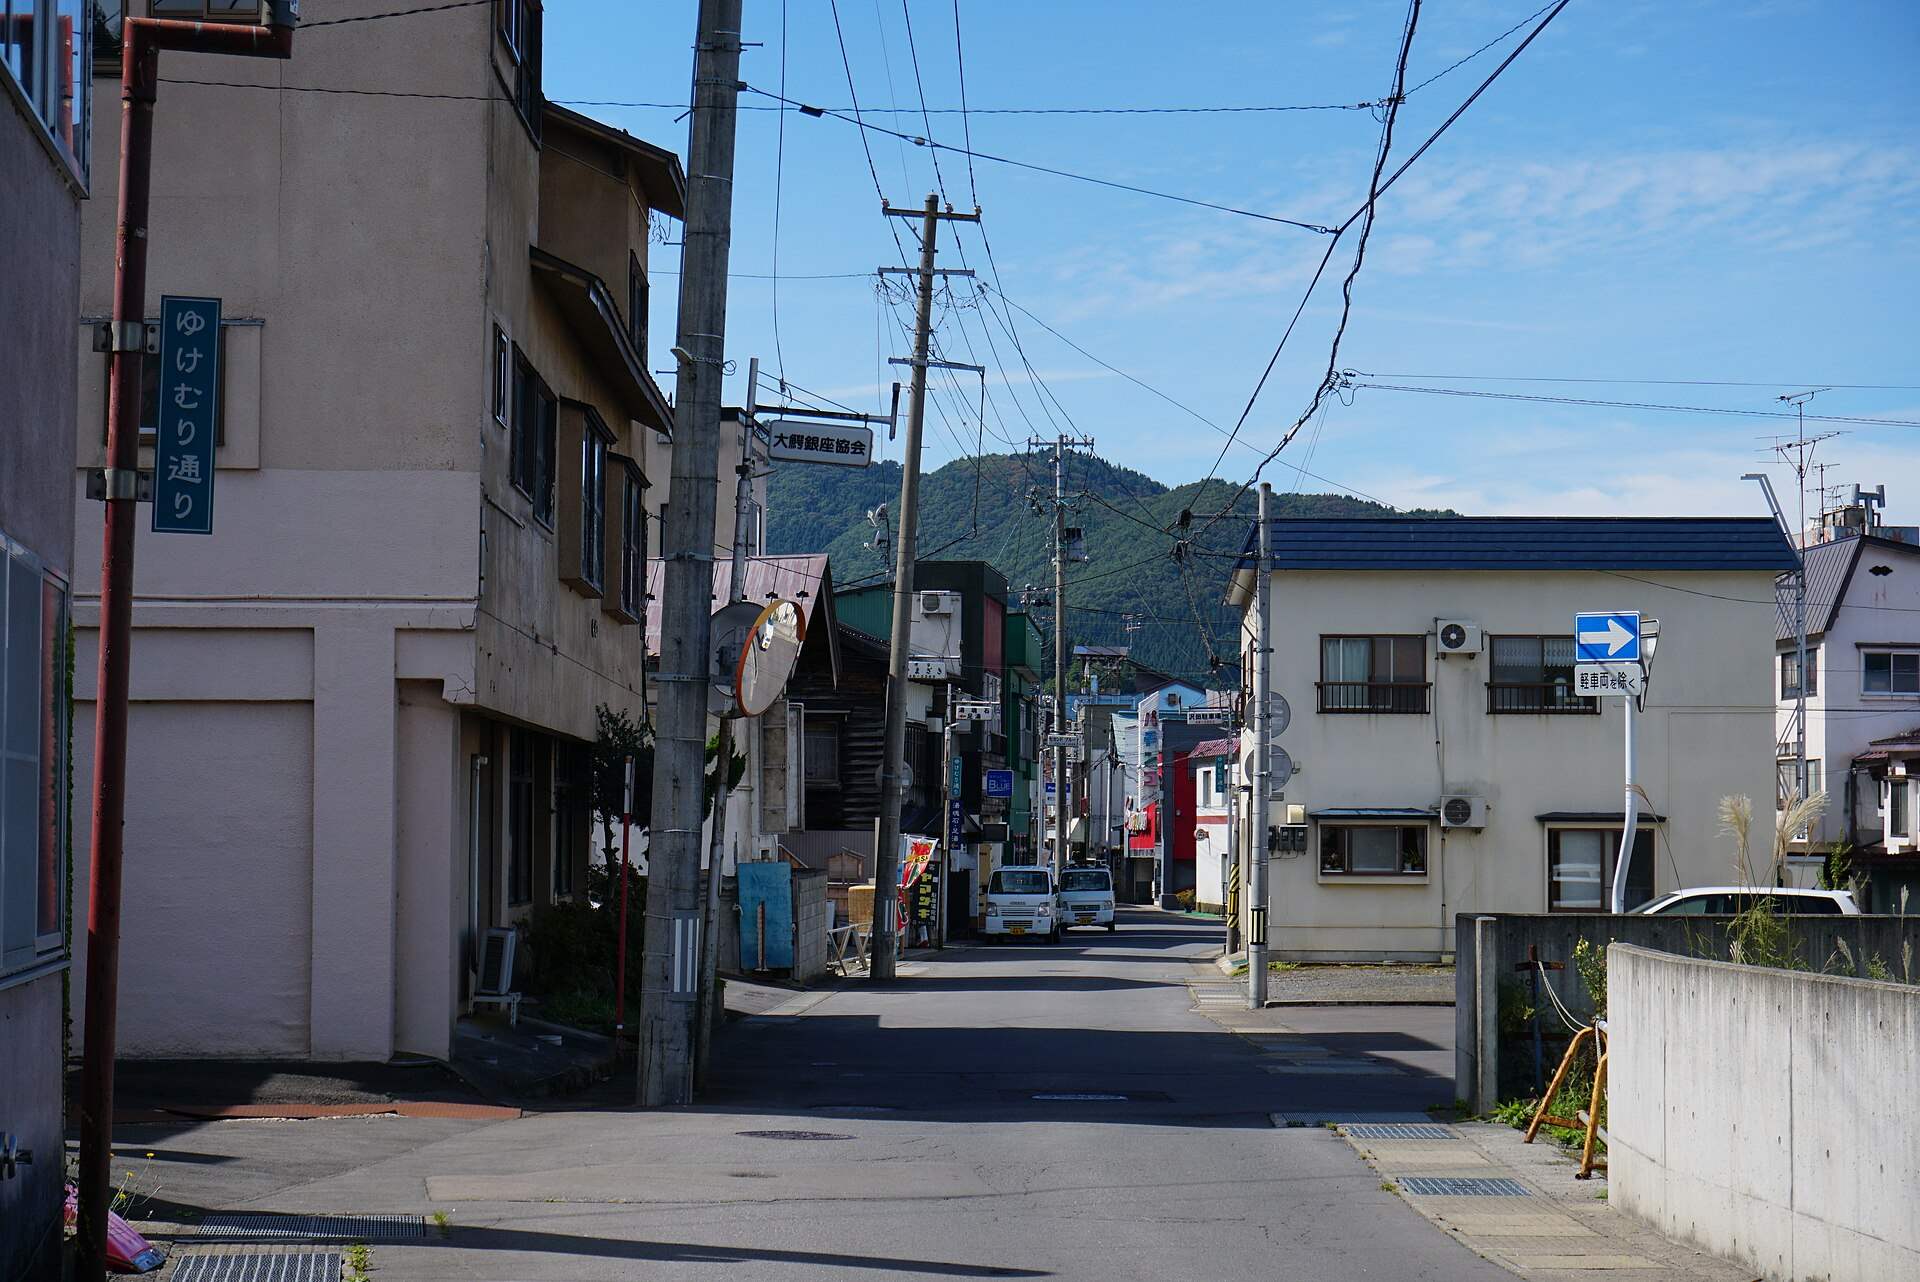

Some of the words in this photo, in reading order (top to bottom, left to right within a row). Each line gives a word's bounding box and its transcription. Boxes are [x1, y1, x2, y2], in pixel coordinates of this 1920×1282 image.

[168, 309, 206, 520] ゆけむり通り
[773, 433, 866, 456] 大鰐銀座協会
[907, 662, 943, 675] まざき
[1580, 671, 1635, 690] 軽車両を除く
[988, 779, 1012, 791] BLUE
